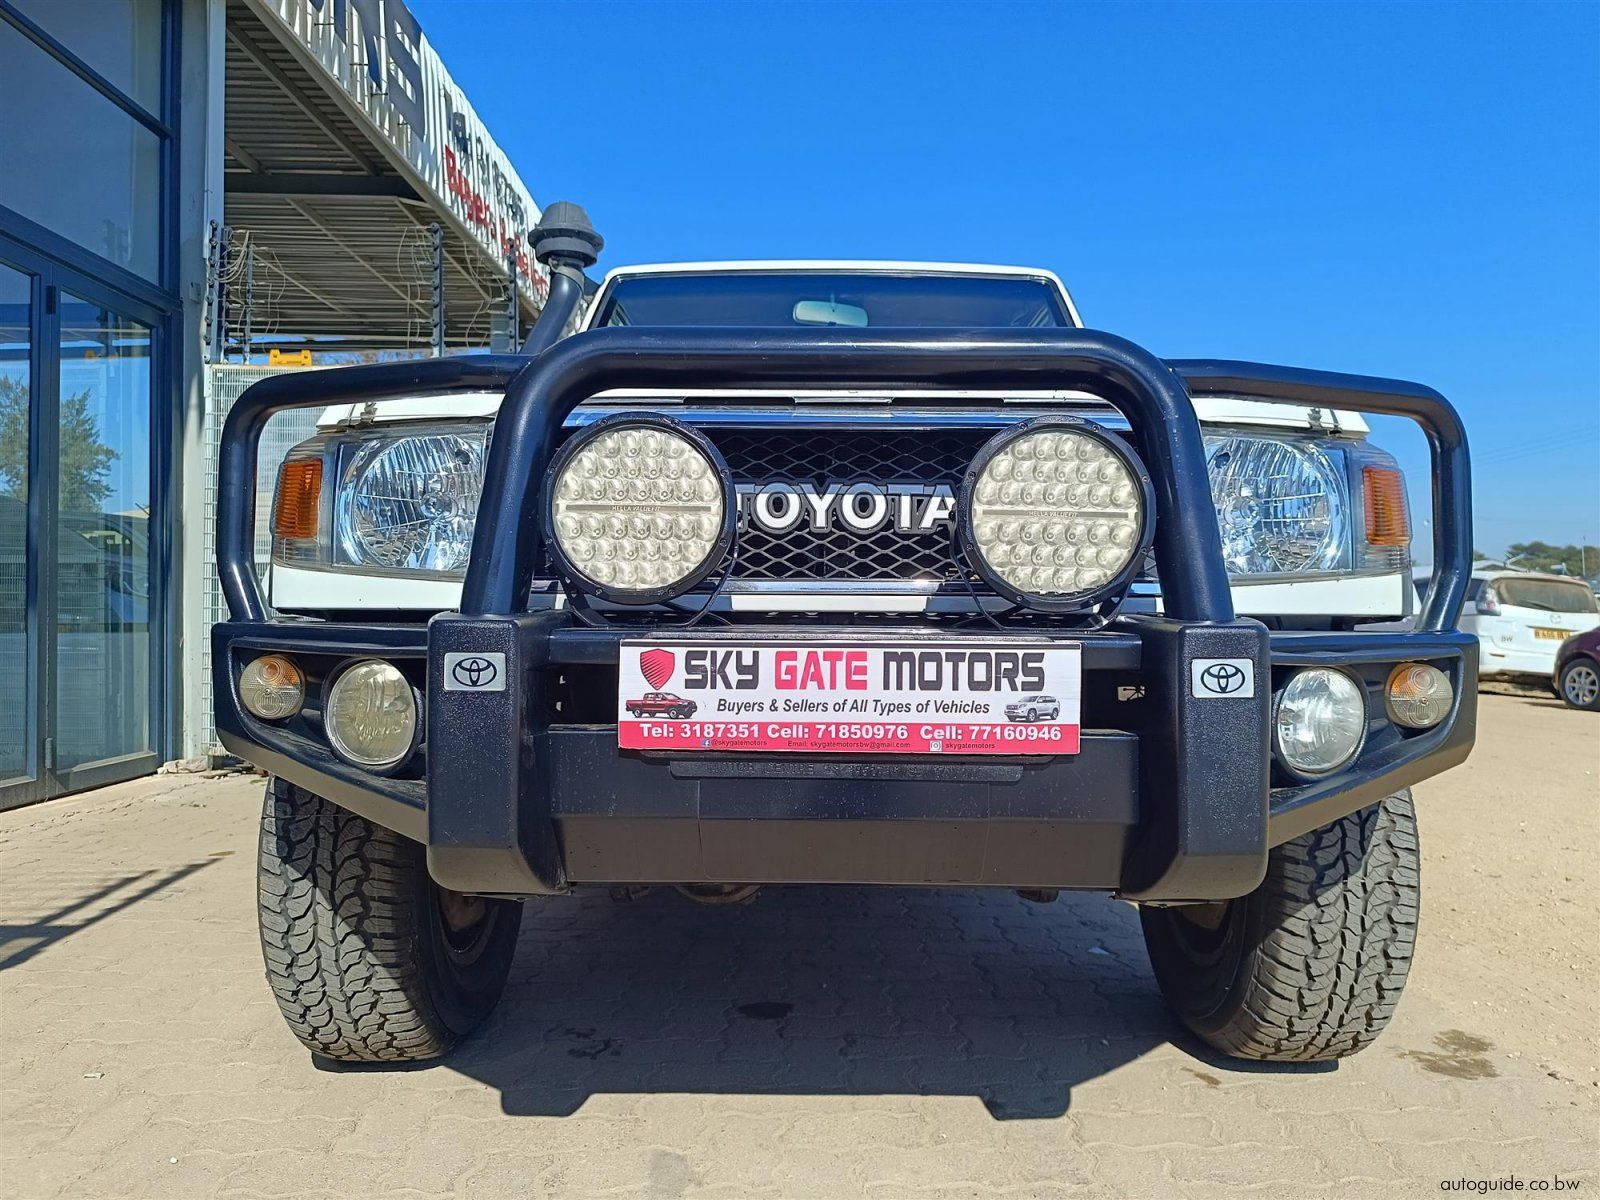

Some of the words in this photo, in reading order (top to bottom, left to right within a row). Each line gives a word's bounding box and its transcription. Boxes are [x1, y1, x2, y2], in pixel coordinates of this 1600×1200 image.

[684, 650, 760, 690] SKY
[774, 650, 868, 691] GATE
[883, 651, 1046, 692] MOTORS
[717, 698, 765, 715] Buyers
[769, 699, 779, 712] &
[783, 698, 829, 713] Sellers
[832, 699, 849, 713] of
[849, 700, 868, 713] All
[872, 700, 912, 716] Types
[916, 700, 931, 713] of
[933, 700, 990, 714] Vehicles
[639, 723, 675, 738] Tel:
[680, 723, 760, 739] 3187351
[767, 724, 810, 739] Cell:
[815, 724, 909, 740] 71850976
[919, 725, 963, 740] Cell:
[969, 725, 1063, 741] 77160946
[810, 740, 911, 749] skygatemotorsbw@gmail.com
[945, 742, 996, 750] skygatemotors
